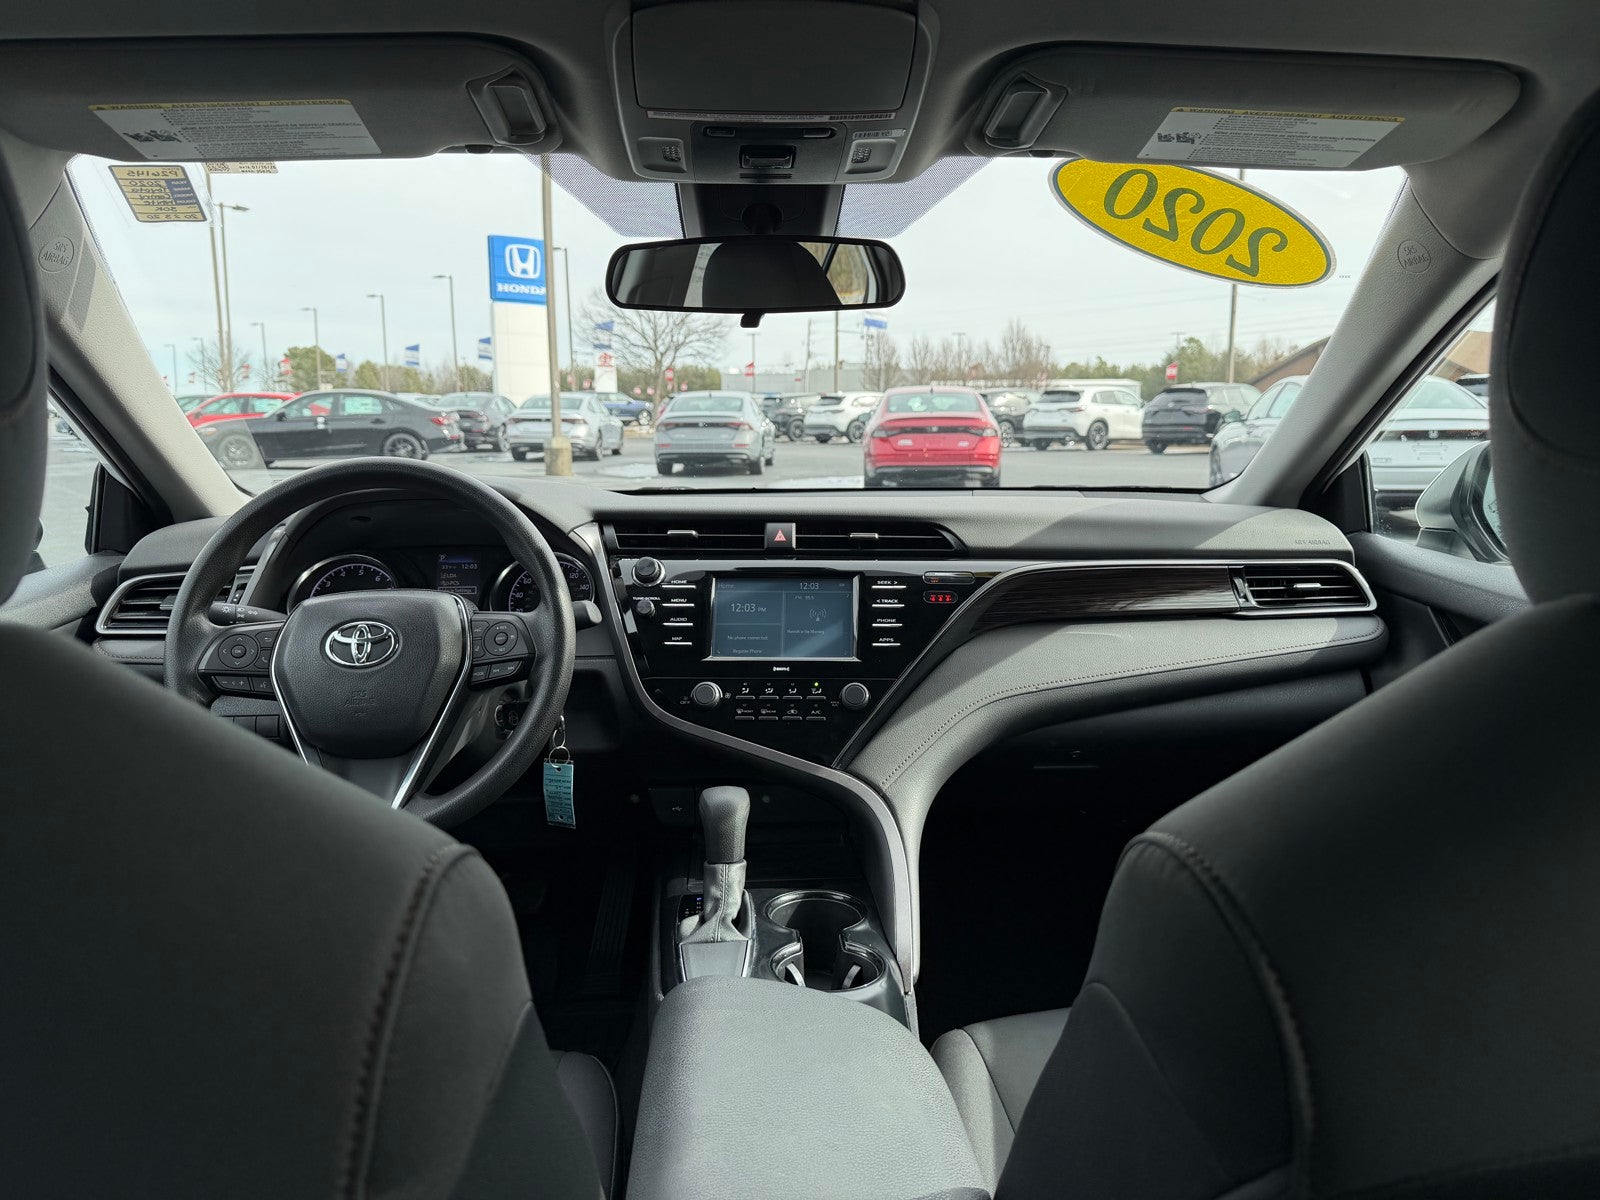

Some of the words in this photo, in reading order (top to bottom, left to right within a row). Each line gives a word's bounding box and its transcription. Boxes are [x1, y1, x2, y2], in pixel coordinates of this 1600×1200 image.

[1189, 107, 1235, 115] WARNING
[800, 582, 819, 590] 12:03
[730, 603, 756, 612] 12:03
